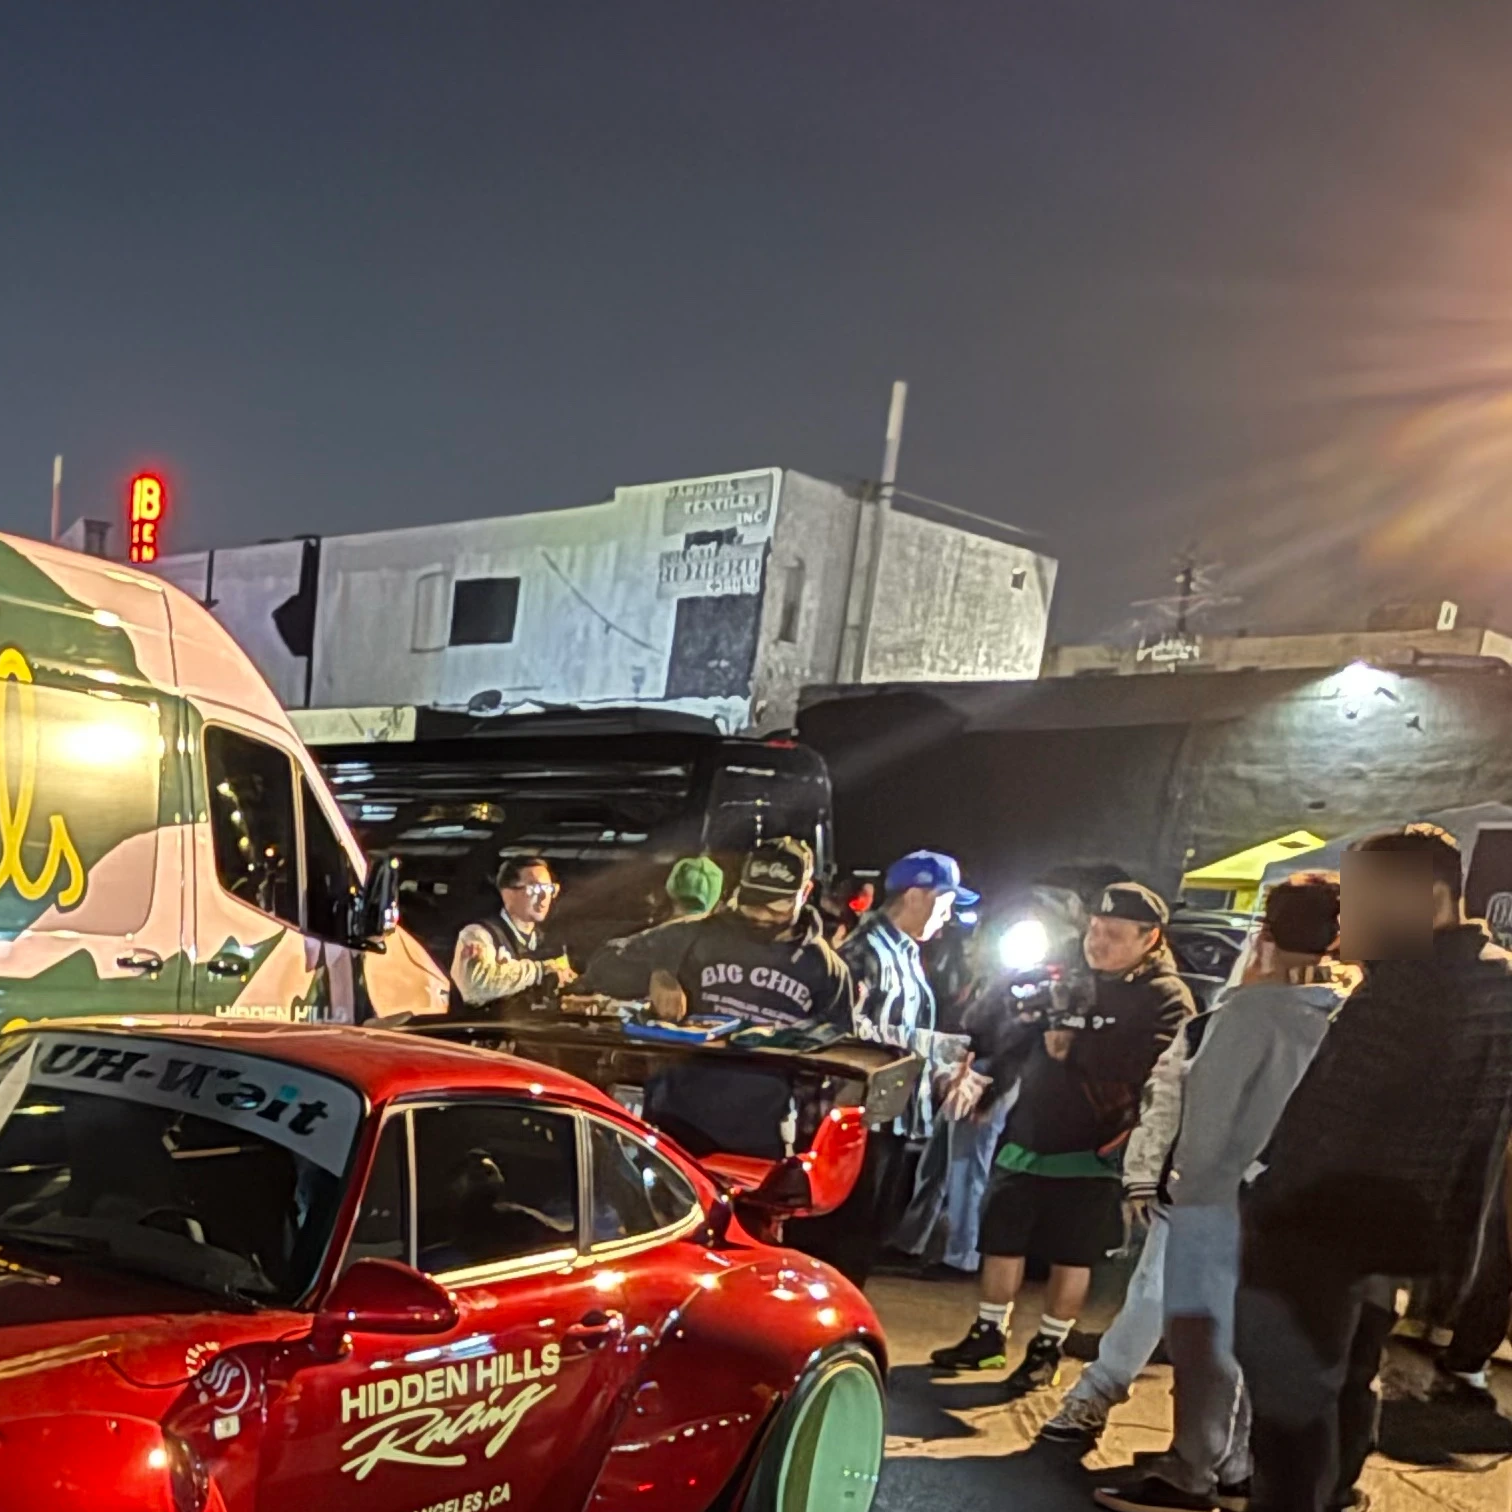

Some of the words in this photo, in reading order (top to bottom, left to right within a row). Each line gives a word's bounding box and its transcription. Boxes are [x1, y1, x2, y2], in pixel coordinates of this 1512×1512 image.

[701, 963, 743, 988] BIG
[341, 1363, 468, 1424] HIDDEN
[476, 1342, 561, 1392] HILLS
[340, 1382, 558, 1481] Racing
